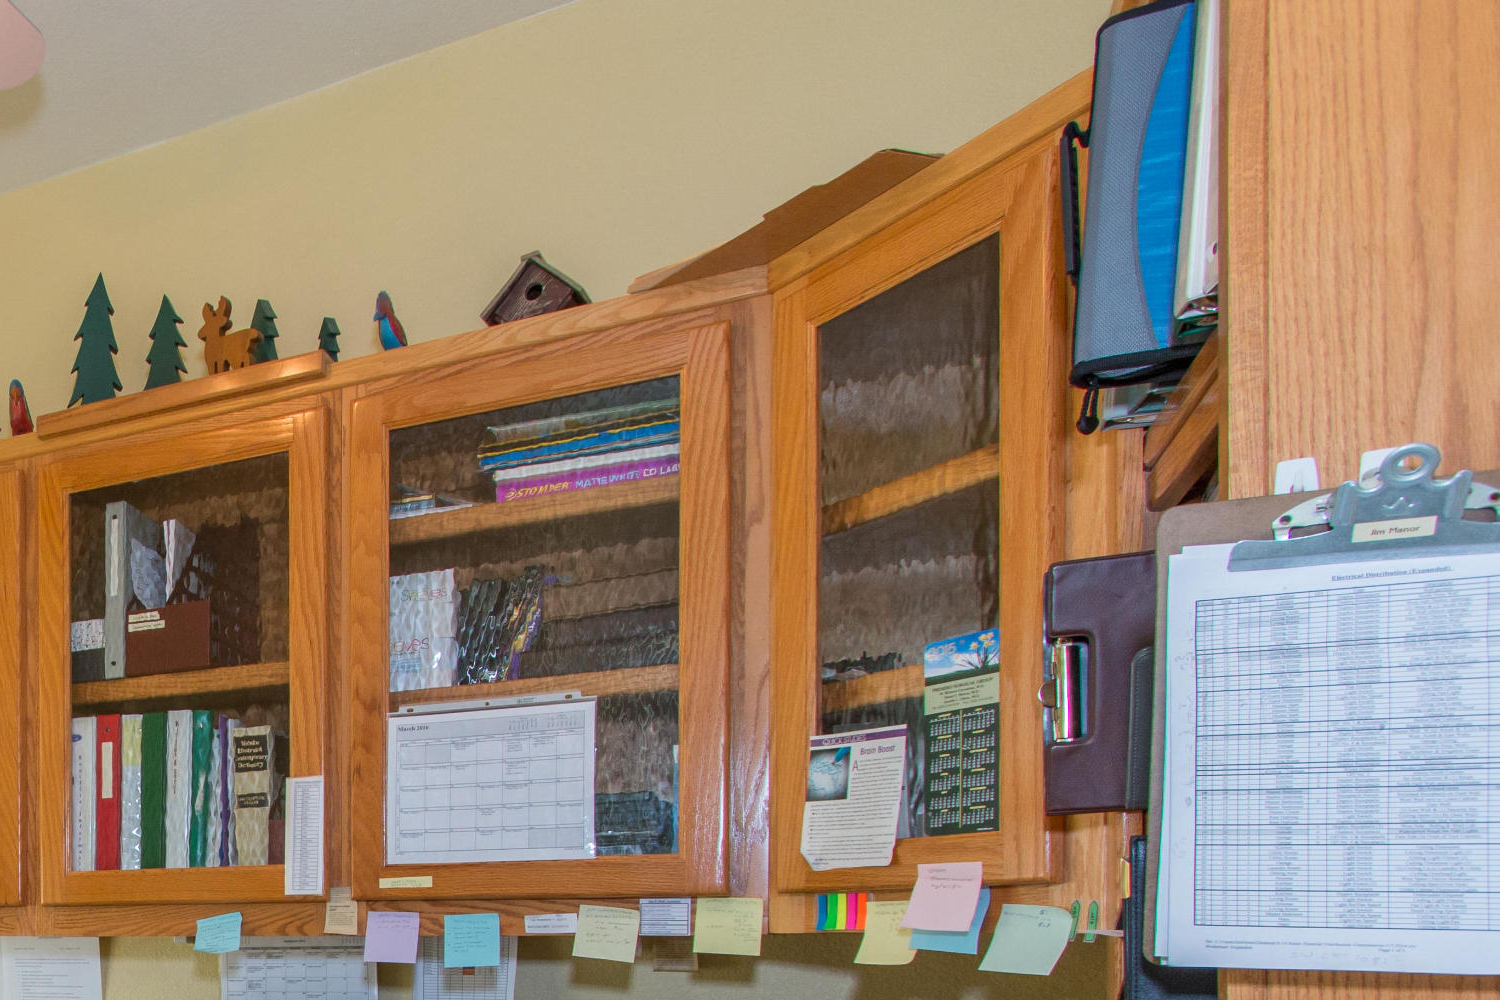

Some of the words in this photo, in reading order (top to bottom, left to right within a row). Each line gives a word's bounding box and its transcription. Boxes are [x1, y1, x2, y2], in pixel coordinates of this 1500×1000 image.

[517, 482, 570, 498] STOMPER
[575, 476, 607, 488] MATTE
[1370, 528, 1385, 536] Jim
[1389, 526, 1420, 534] Manor
[860, 747, 876, 756] Brain
[878, 745, 896, 754] Boost
